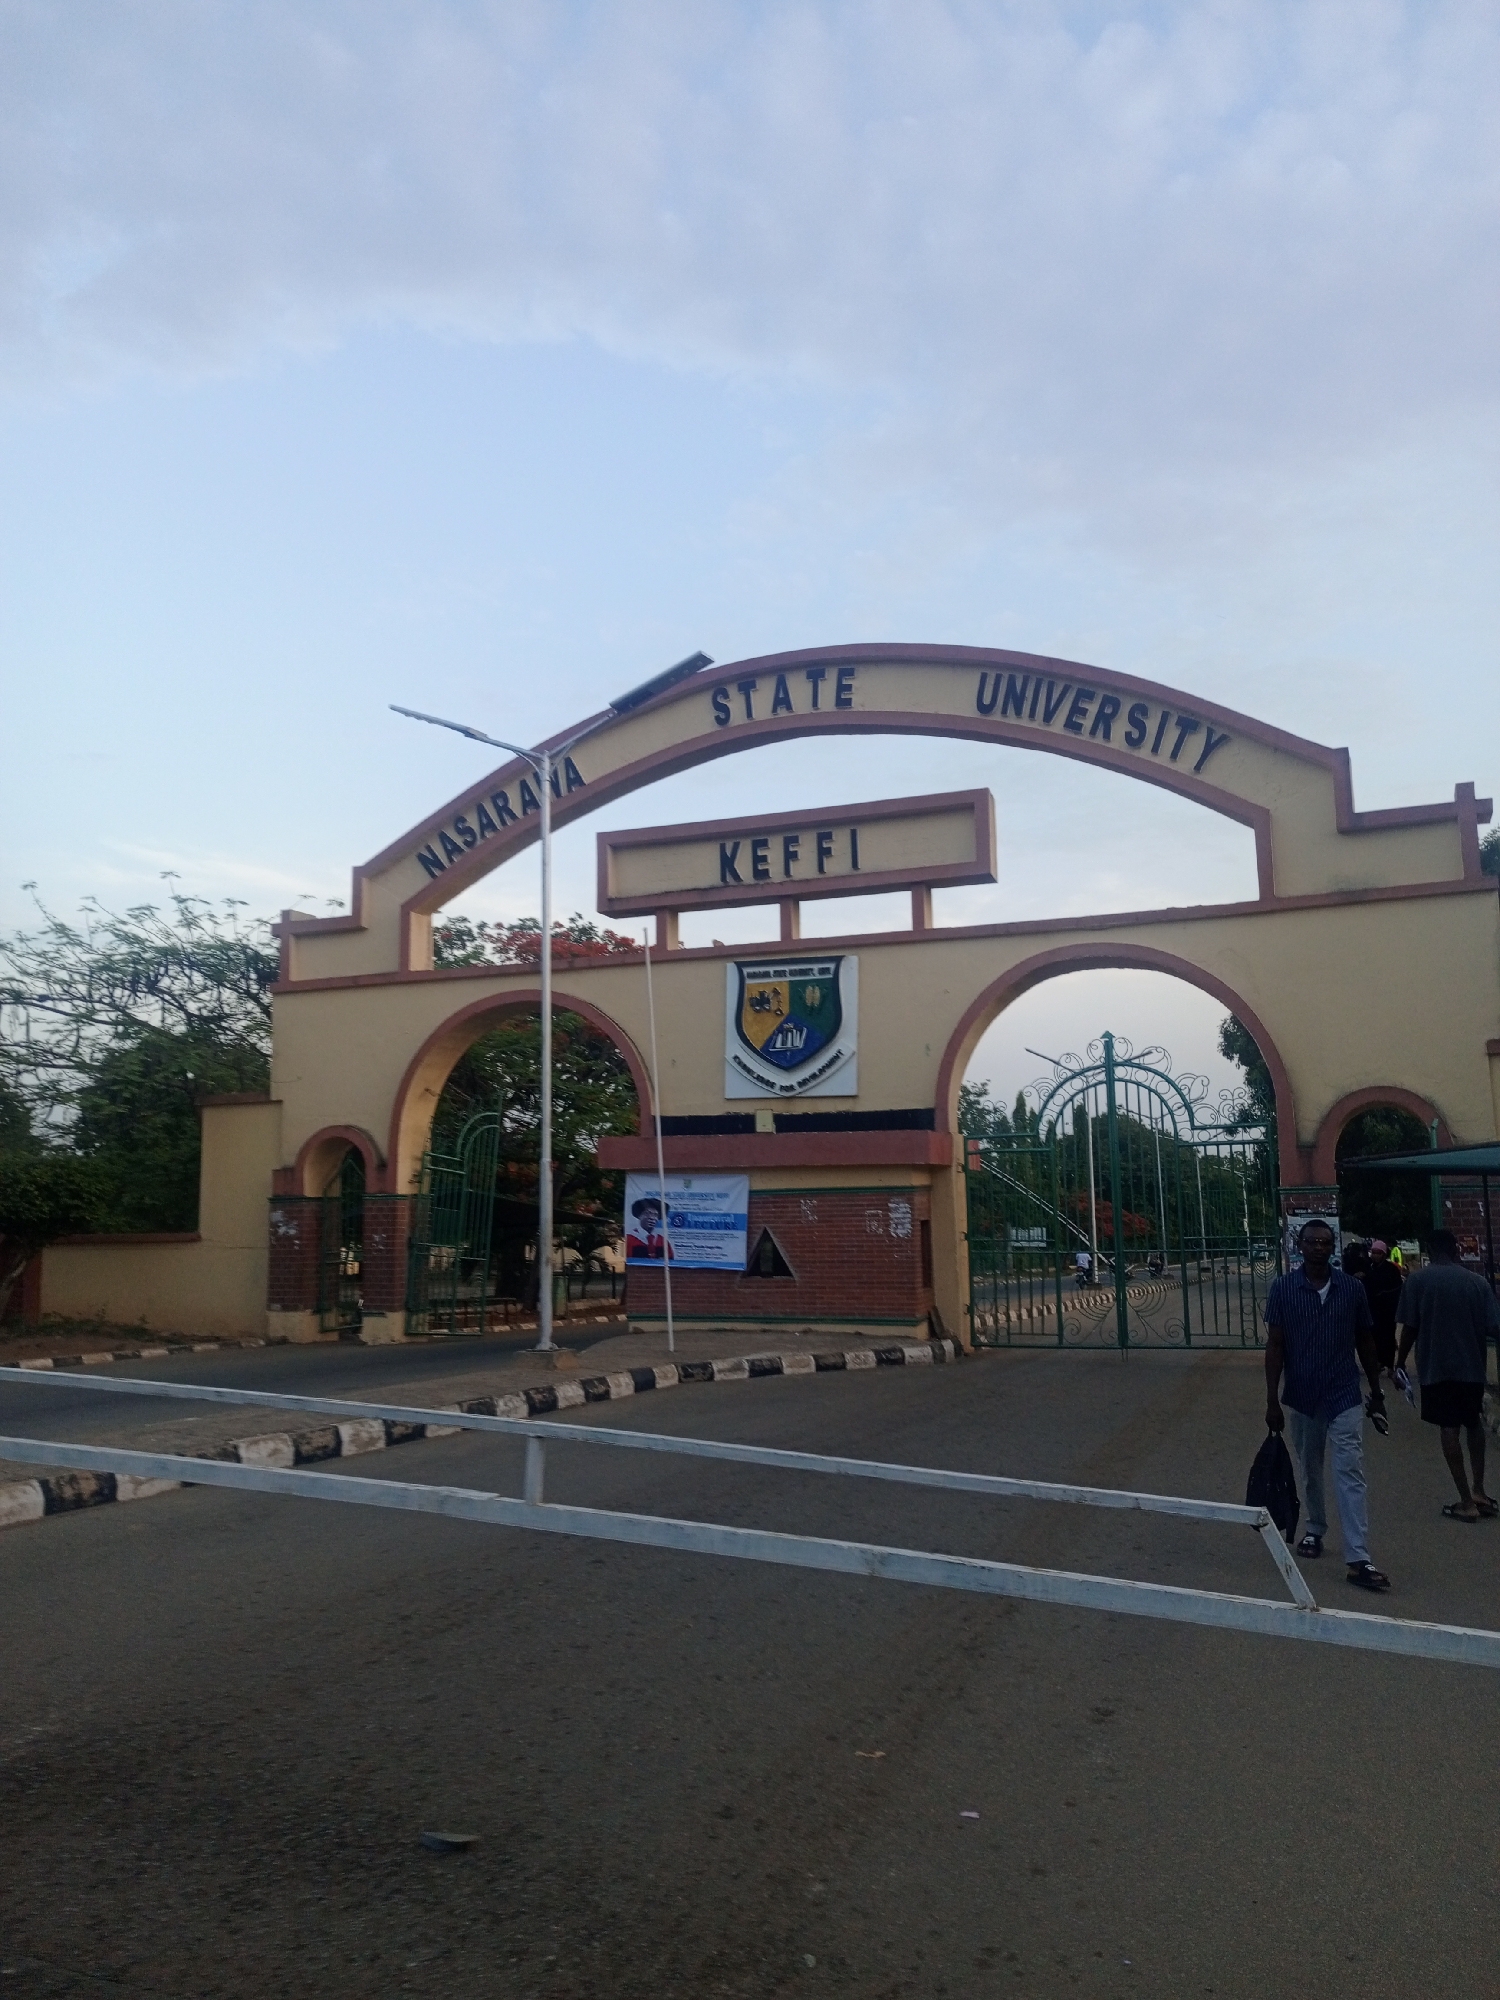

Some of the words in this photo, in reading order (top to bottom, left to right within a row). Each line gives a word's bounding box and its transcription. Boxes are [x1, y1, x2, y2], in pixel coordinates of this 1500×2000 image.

[416, 756, 587, 880] NASARAWA
[711, 667, 855, 727] STATE
[976, 671, 1231, 773] UNIVERSITY
[719, 828, 860, 884] KEFFI
